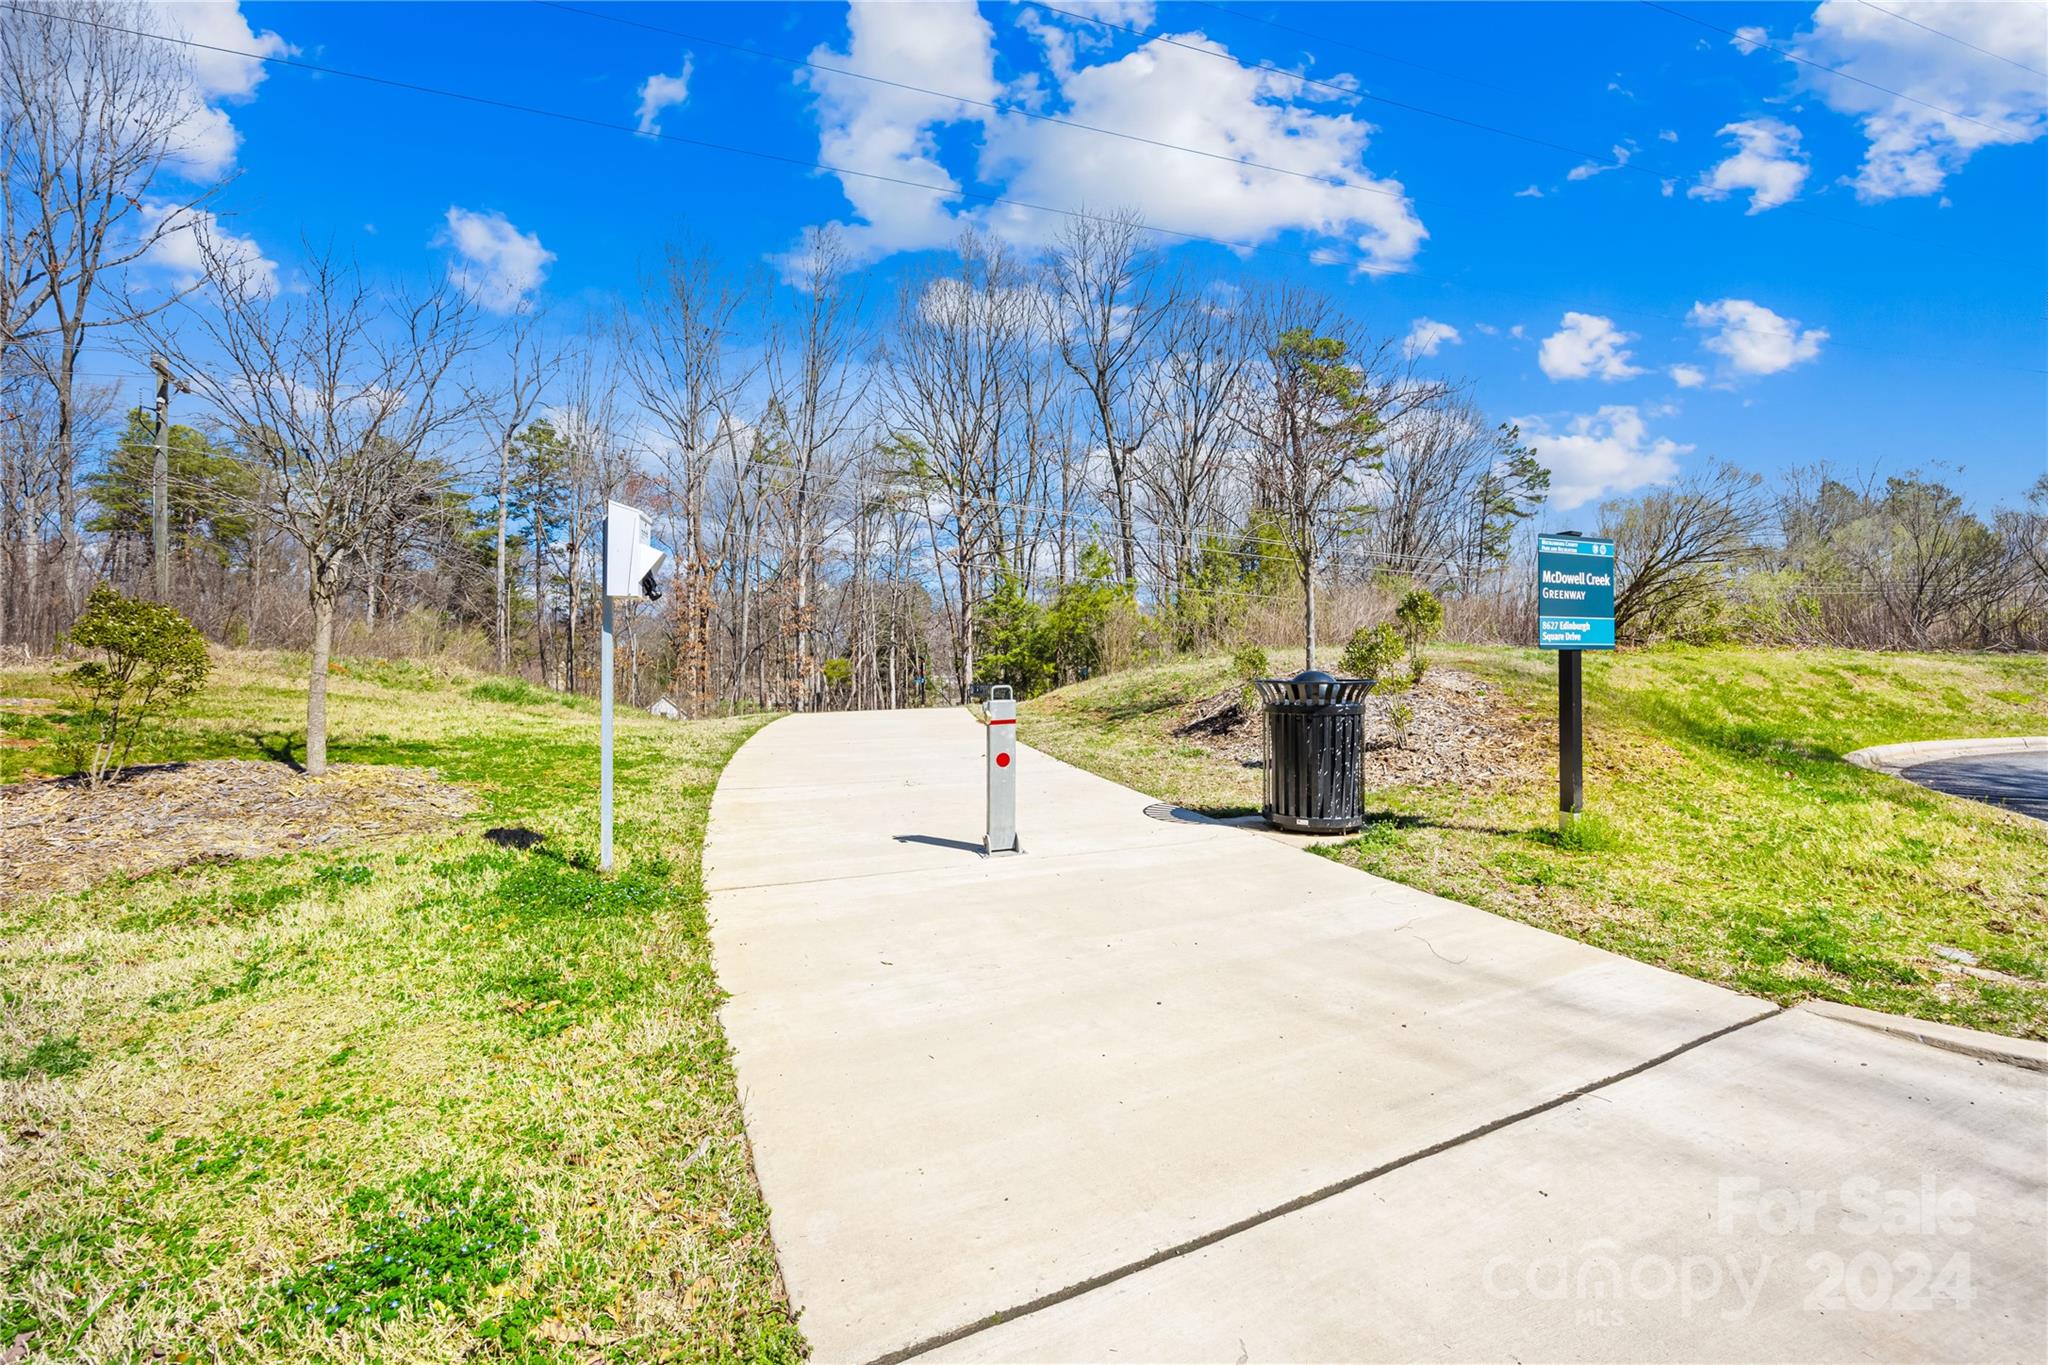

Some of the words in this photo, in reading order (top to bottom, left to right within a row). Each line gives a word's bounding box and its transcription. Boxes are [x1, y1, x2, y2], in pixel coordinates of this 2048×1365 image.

[1543, 570, 1585, 585] McDowell
[1586, 573, 1610, 586] Creek
[1542, 587, 1586, 600] GREENWAY
[1560, 621, 1591, 632] Edinburgh
[1542, 632, 1564, 642] Square
[1566, 632, 1581, 641] Drive
